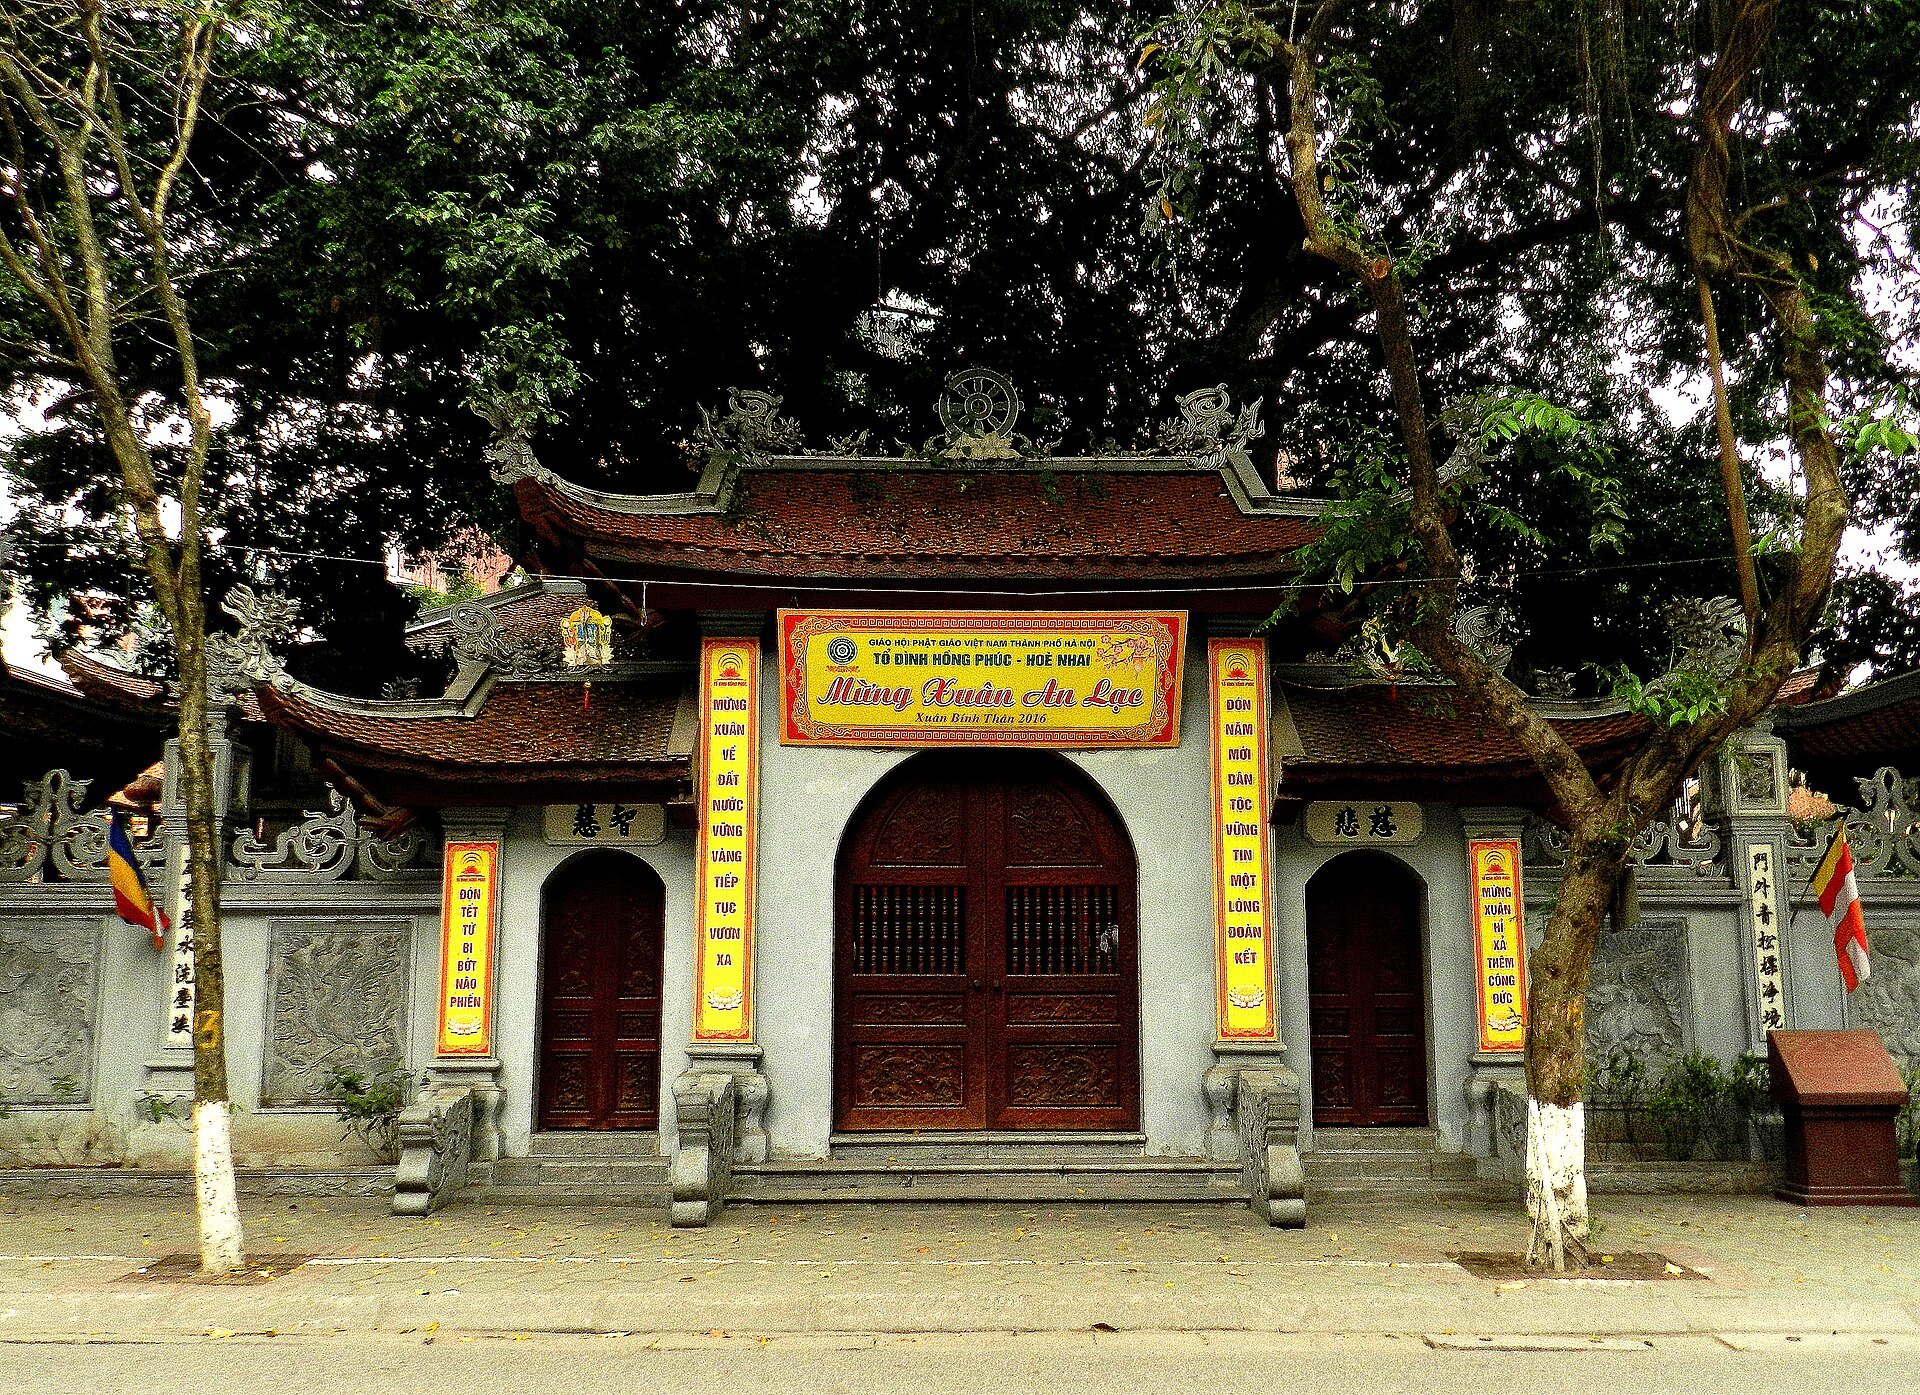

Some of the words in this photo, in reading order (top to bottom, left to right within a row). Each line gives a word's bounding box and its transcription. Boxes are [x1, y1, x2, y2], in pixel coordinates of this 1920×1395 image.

[869, 637, 892, 647] GIÁO
[895, 637, 910, 649] HỘI
[912, 637, 936, 649] PHẬT
[939, 637, 962, 647] GIÁO
[965, 638, 984, 649] VIỆT
[1010, 638, 1041, 647] THÀNH
[1044, 637, 1062, 647] PHỐ
[1065, 638, 1077, 647] HÀ
[1080, 639, 1096, 650] NỘI
[873, 648, 891, 666] TỔ
[894, 651, 928, 666] ĐÌNH
[932, 650, 971, 666] HỒNG
[975, 652, 1012, 667] PHÚC
[1058, 655, 1091, 667] NHAI
[817, 675, 914, 712] Mừng
[921, 677, 1015, 707] Xuân
[1021, 678, 1080, 708] An
[1081, 678, 1144, 714] Lạc
[713, 698, 747, 711] MỪNG
[1227, 697, 1251, 711] ĐÓN
[914, 713, 947, 722] Xuân
[984, 713, 1015, 723] Thân
[1018, 714, 1047, 723] 2016
[714, 723, 745, 736] XUÂN
[1226, 722, 1253, 736] NĂM
[1229, 746, 1251, 760] MỚI
[717, 772, 740, 786] ĐẤT
[1228, 772, 1253, 786] DÂN
[712, 796, 744, 811] NƯỚC
[1230, 796, 1253, 812] TỘC
[713, 822, 743, 837] VỮNG
[1226, 822, 1258, 836] VỮNG
[711, 847, 742, 862] VÀNG
[1233, 849, 1253, 861] TIN
[714, 871, 739, 888] TIẾP
[1231, 872, 1256, 890] MỘT
[460, 887, 480, 900] ĐÓN
[1482, 884, 1511, 898] MỪNG
[461, 903, 478, 918] TẾT
[715, 901, 736, 917] TỤC
[1229, 897, 1260, 912] LÒNG
[1485, 902, 1511, 915] XUÂN
[710, 926, 740, 939] VƯƠN
[1228, 924, 1262, 938] ĐOÀN
[463, 942, 473, 954] BI
[717, 954, 732, 966] XA
[1235, 948, 1256, 964] KẾT
[1487, 956, 1514, 969] THÊM
[458, 958, 477, 972] BỚT
[1489, 973, 1515, 986] CÔNG
[1493, 989, 1512, 1004] ĐỨC
